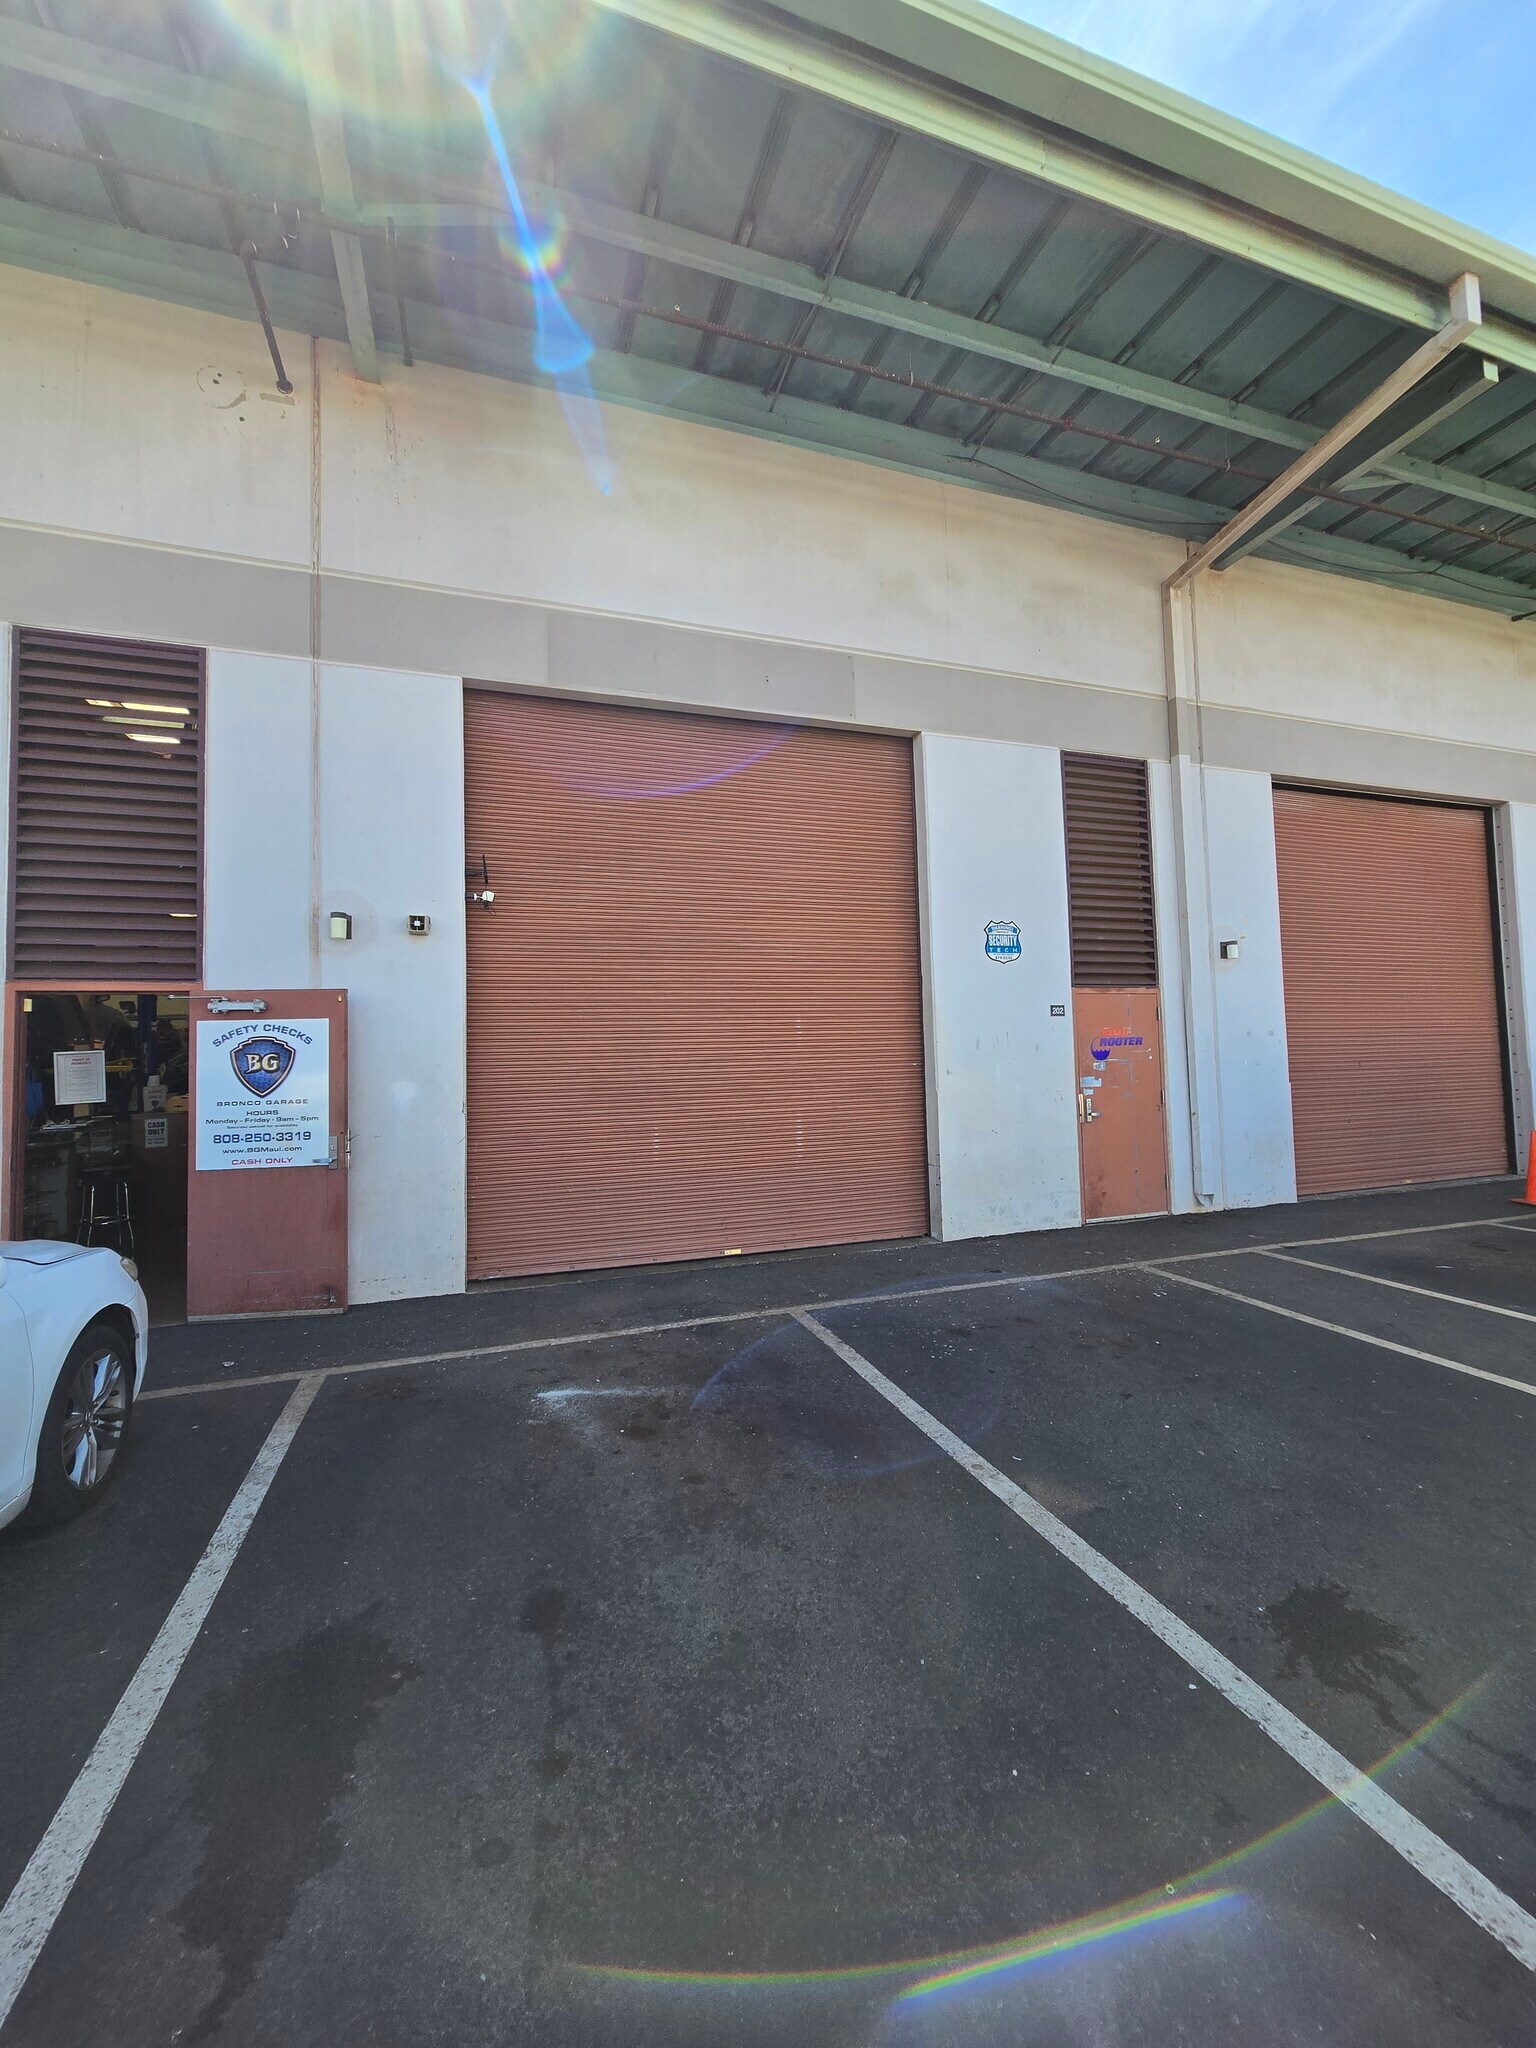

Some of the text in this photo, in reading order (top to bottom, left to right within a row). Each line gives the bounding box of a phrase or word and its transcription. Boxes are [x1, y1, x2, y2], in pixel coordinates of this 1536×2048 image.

[988, 935, 1017, 946] SECURITY
[212, 1024, 313, 1047] SAFETY CHECKS
[1099, 1036, 1143, 1046] ROOTER
[245, 1053, 280, 1074] BG
[265, 1098, 309, 1106] GARAGE
[147, 1128, 165, 1136] ONLY
[222, 1146, 303, 1154] www.BGMaui.com
